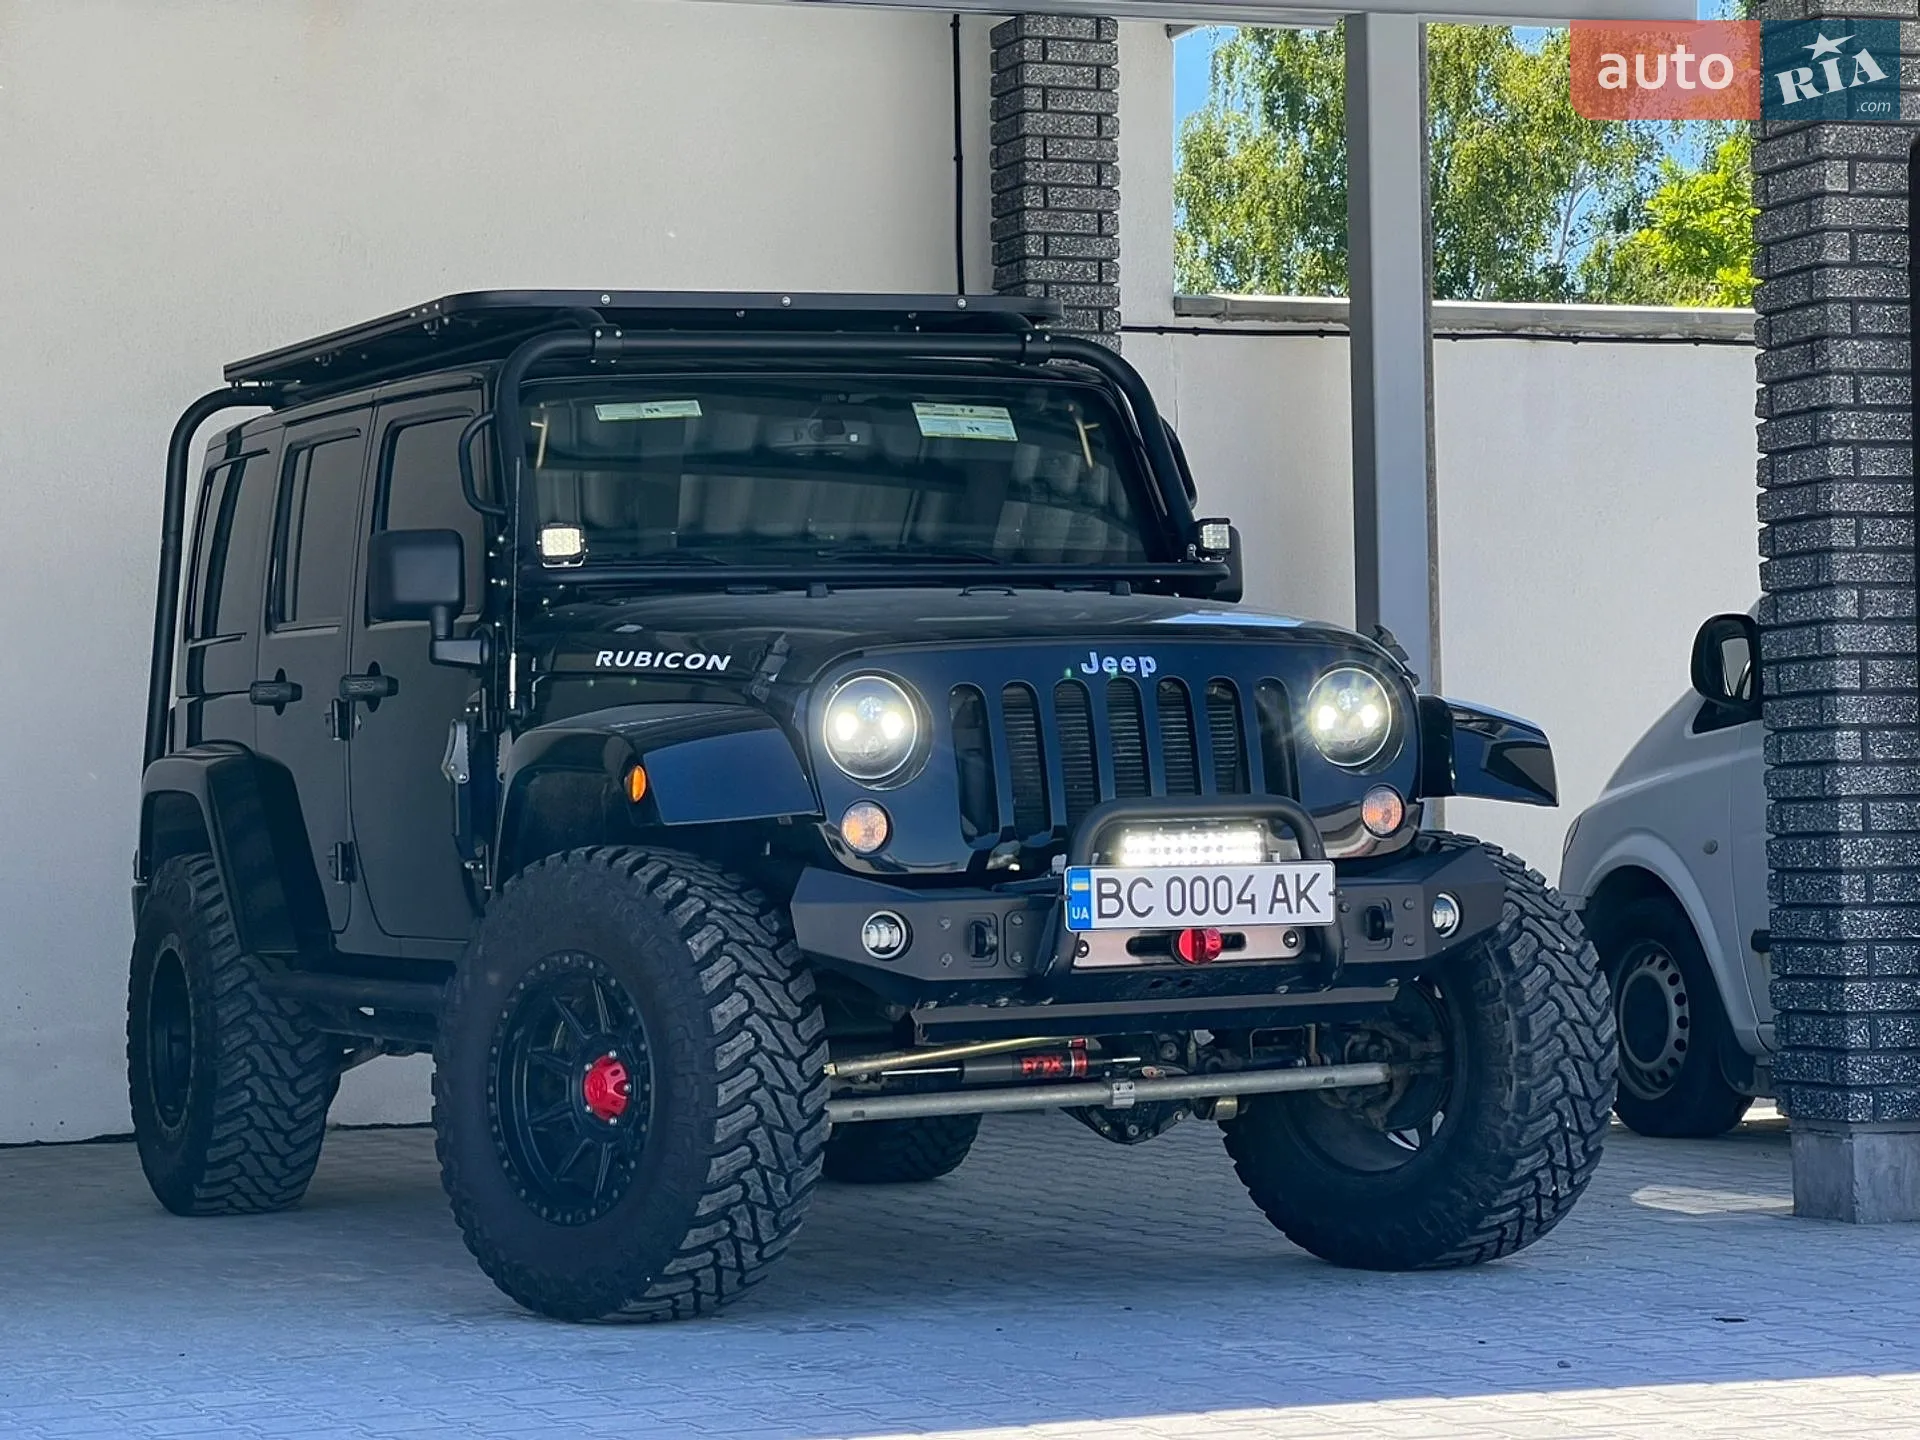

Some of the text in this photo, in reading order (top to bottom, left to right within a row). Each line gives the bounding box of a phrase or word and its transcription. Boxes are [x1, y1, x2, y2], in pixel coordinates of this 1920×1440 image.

[595, 650, 731, 671] RUBICON
[1080, 651, 1157, 678] Jeep
[1096, 872, 1321, 920] BC 0004 AK
[1072, 907, 1089, 920] UA
